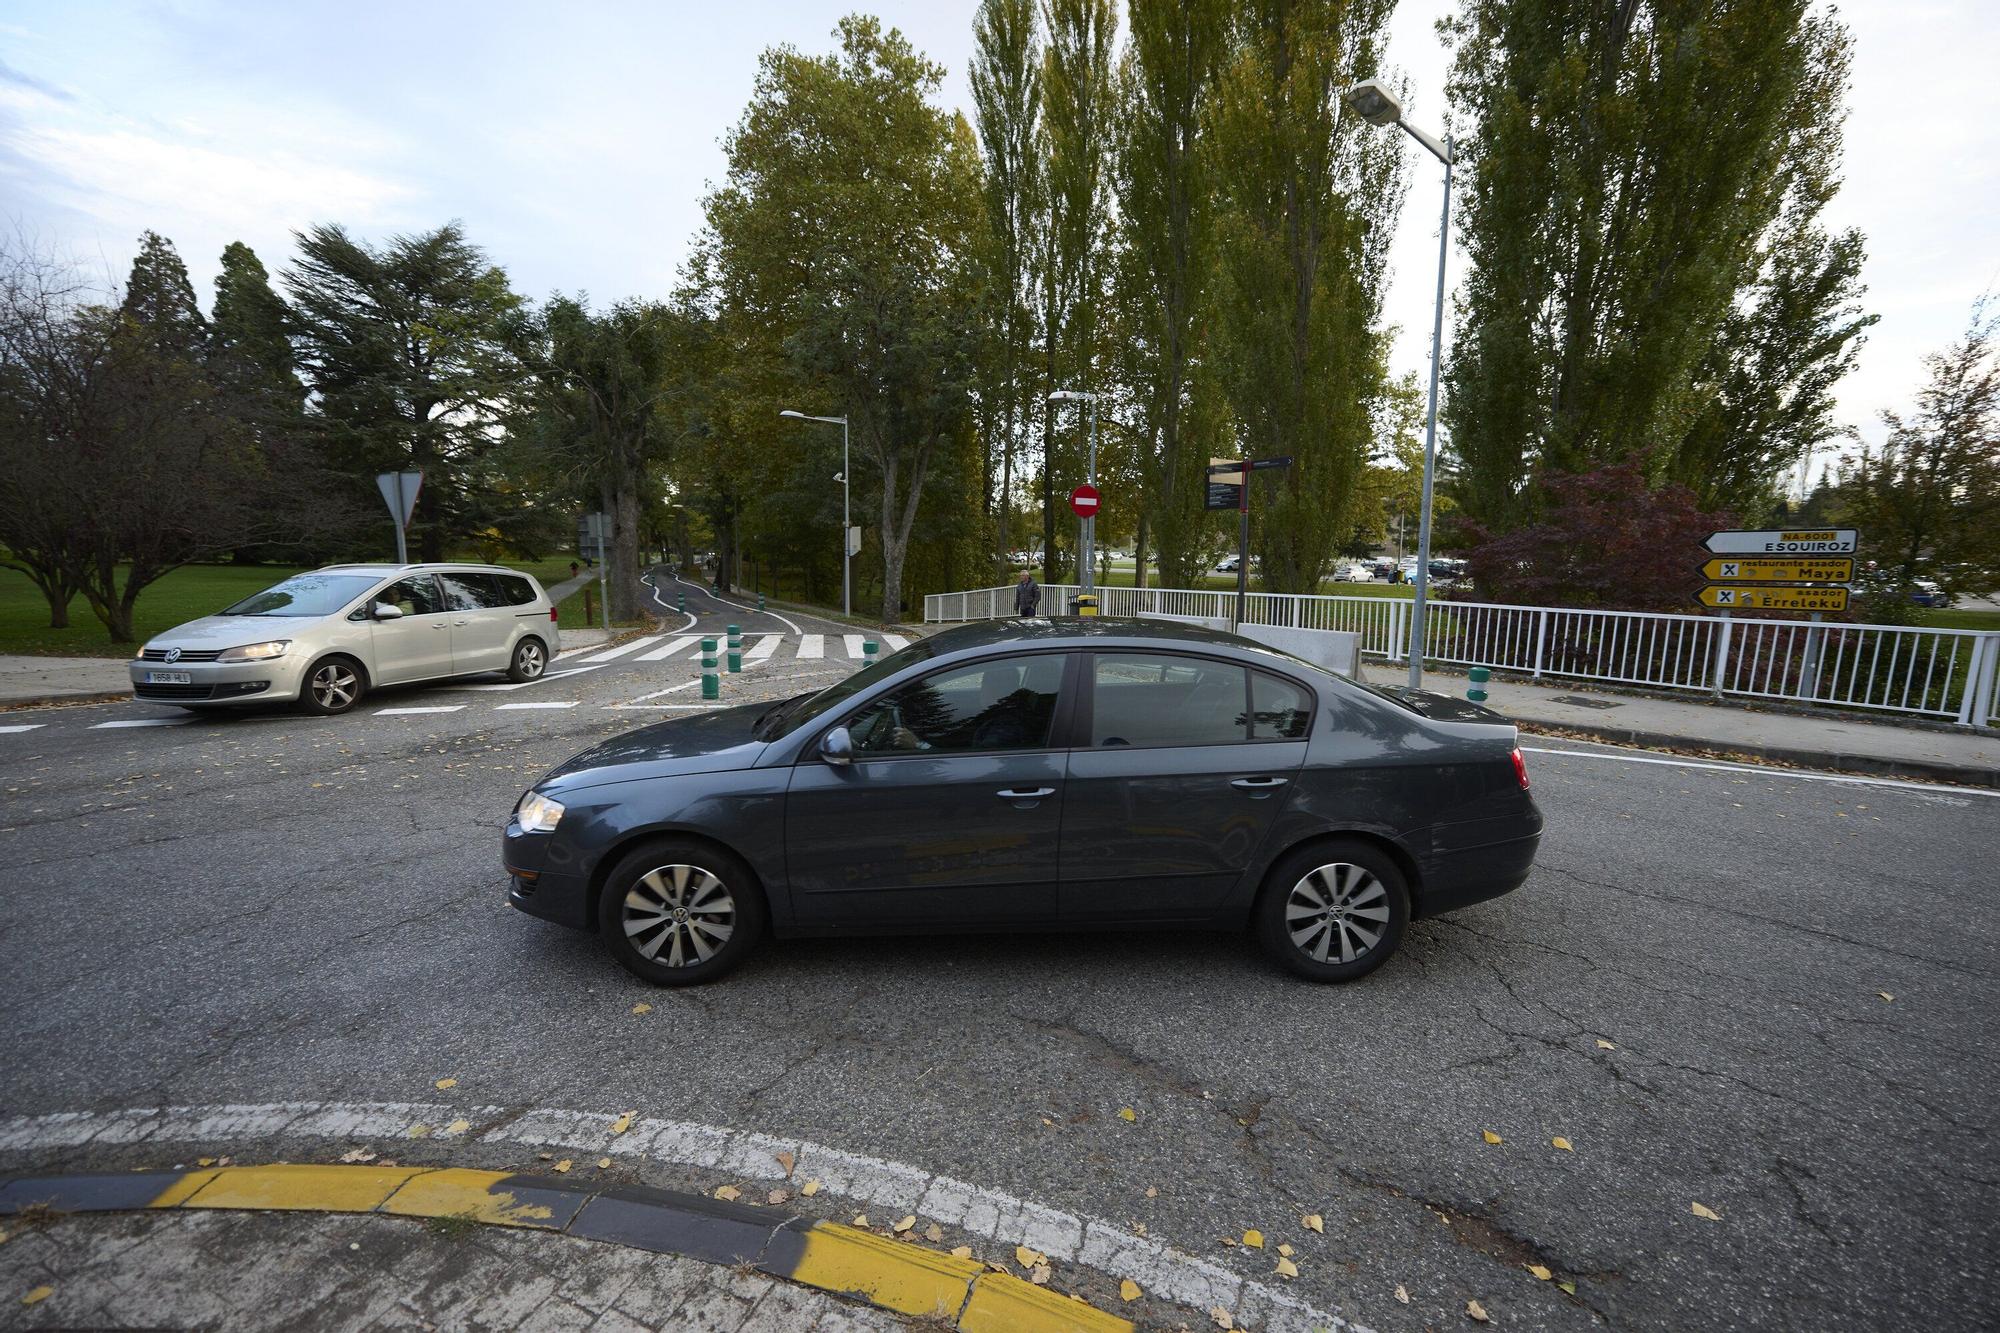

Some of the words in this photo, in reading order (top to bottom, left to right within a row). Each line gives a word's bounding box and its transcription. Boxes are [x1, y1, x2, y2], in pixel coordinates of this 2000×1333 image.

[1782, 533, 1836, 541] NA-6001
[1765, 542, 1851, 552] ESQUIROZ
[1799, 568, 1845, 580] Maya
[1796, 589, 1843, 597] asador
[1762, 597, 1842, 609] Erreleku
